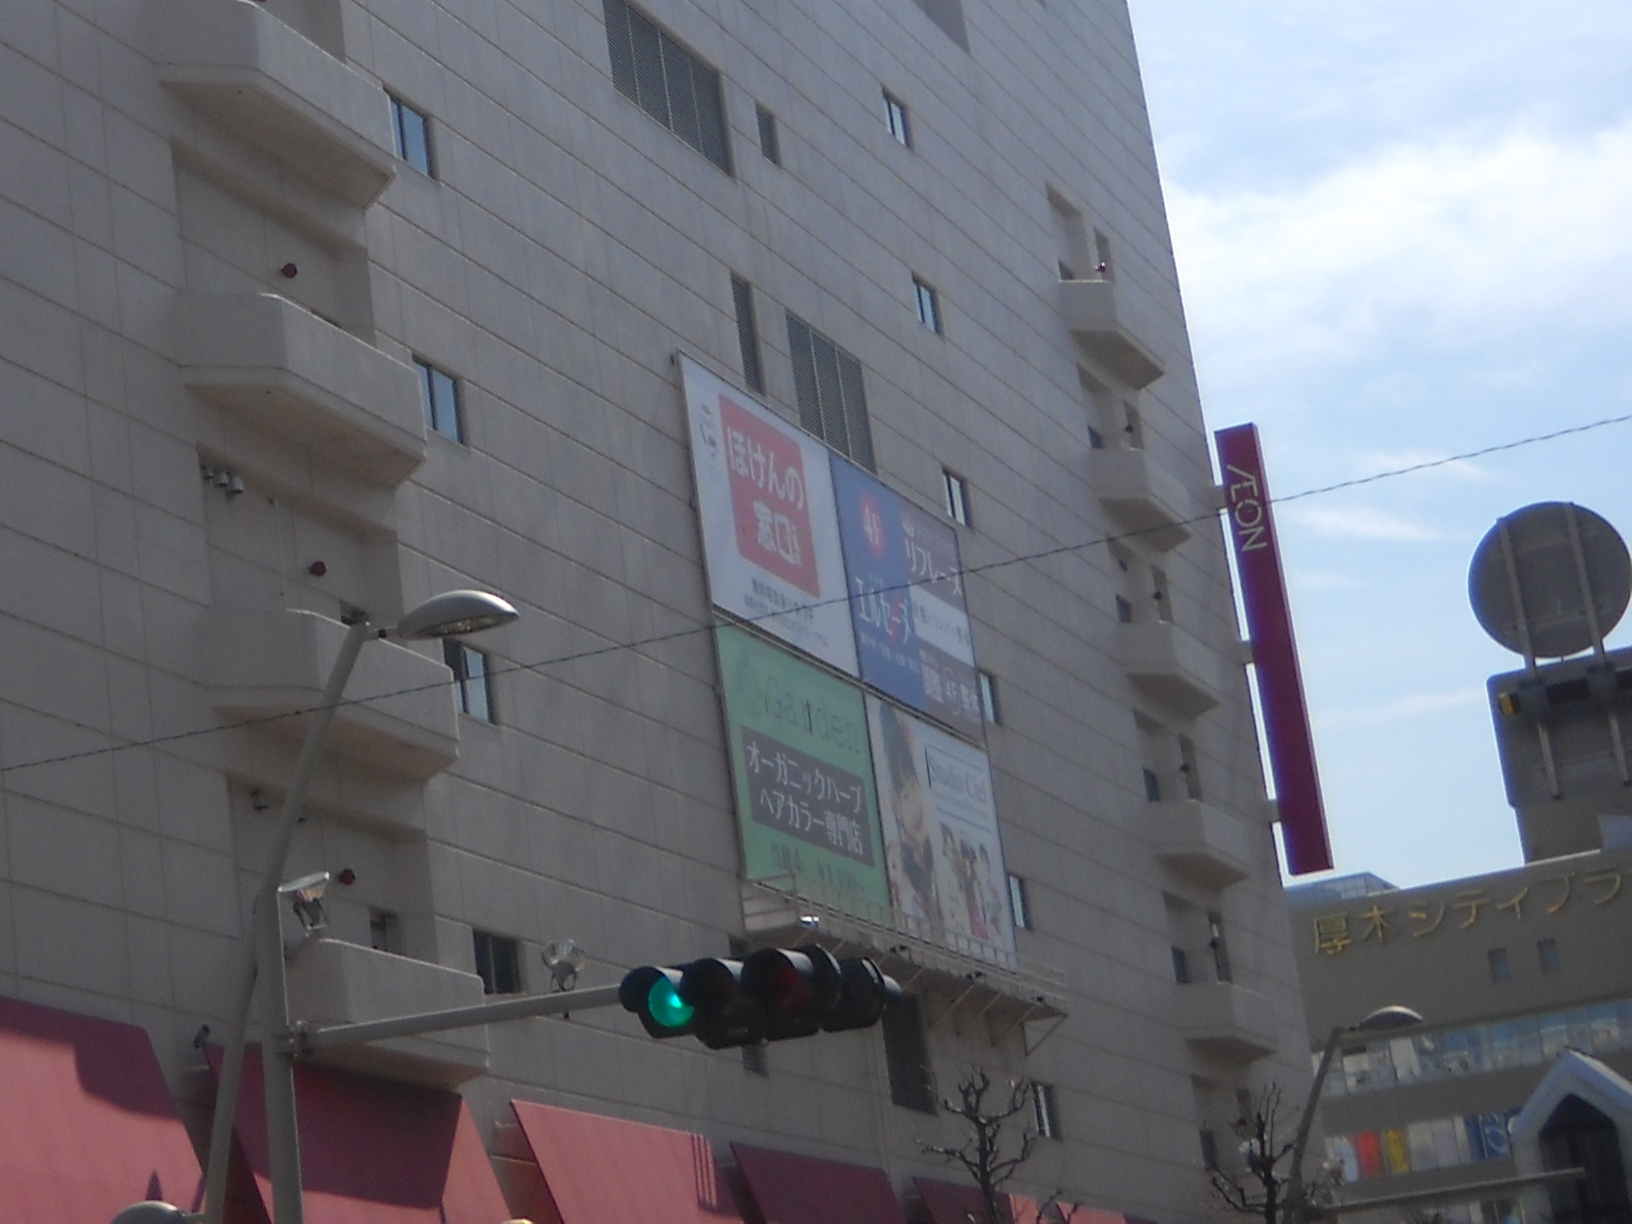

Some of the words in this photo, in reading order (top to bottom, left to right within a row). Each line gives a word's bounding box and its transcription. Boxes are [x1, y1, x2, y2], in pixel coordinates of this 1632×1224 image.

[726, 426, 805, 511] ほけんの
[753, 499, 803, 567] 窓口
[768, 677, 860, 754] Garden
[746, 740, 864, 814] オーガニックハーブ
[759, 786, 864, 856] ヘアカラー専門店
